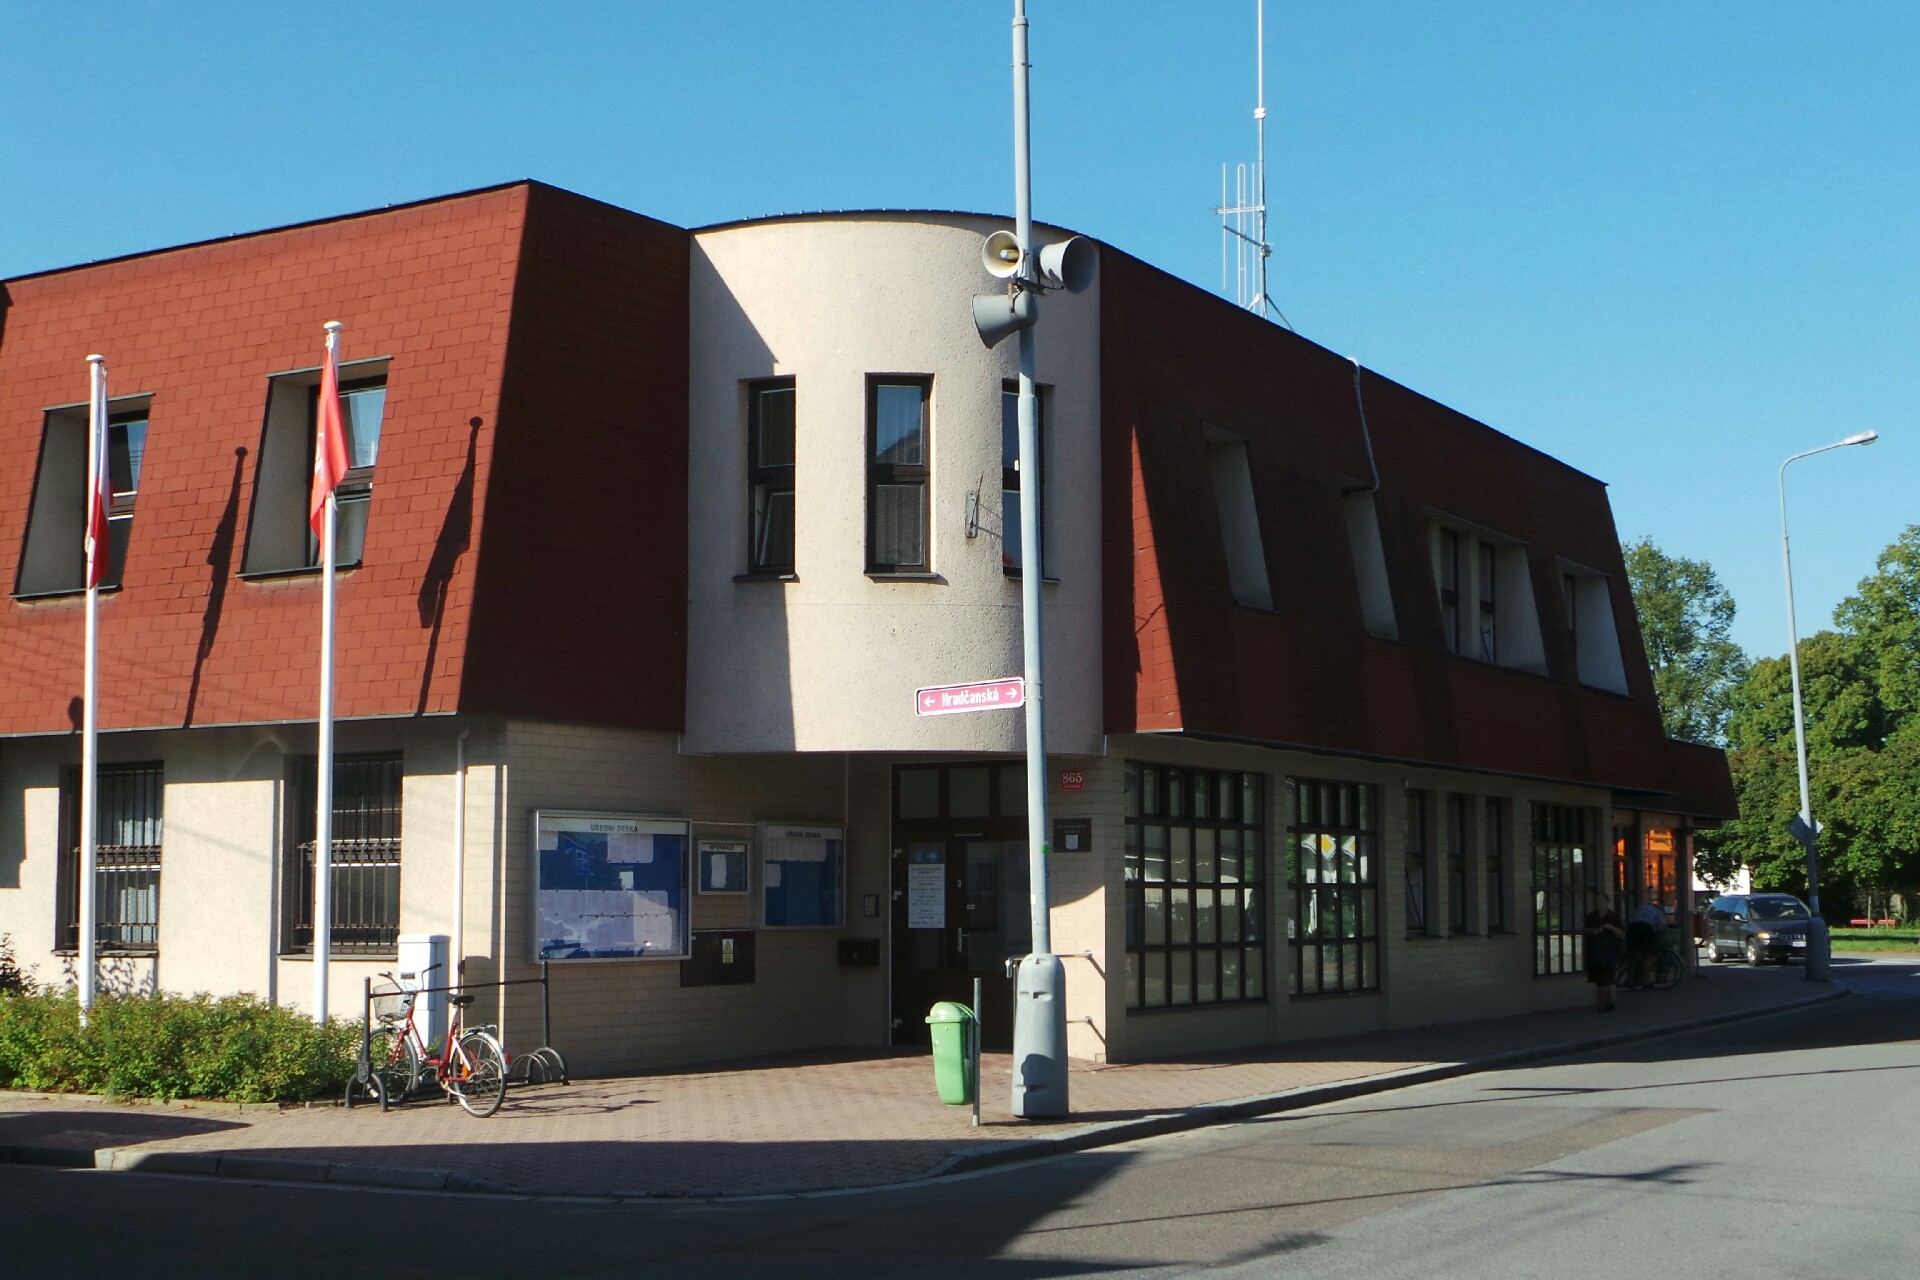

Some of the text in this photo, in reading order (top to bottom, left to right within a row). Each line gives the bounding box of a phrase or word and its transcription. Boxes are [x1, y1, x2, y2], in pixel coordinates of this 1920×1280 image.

[942, 687, 999, 707] Hradčanská
[1062, 772, 1082, 784] 865
[617, 824, 639, 832] DESKA
